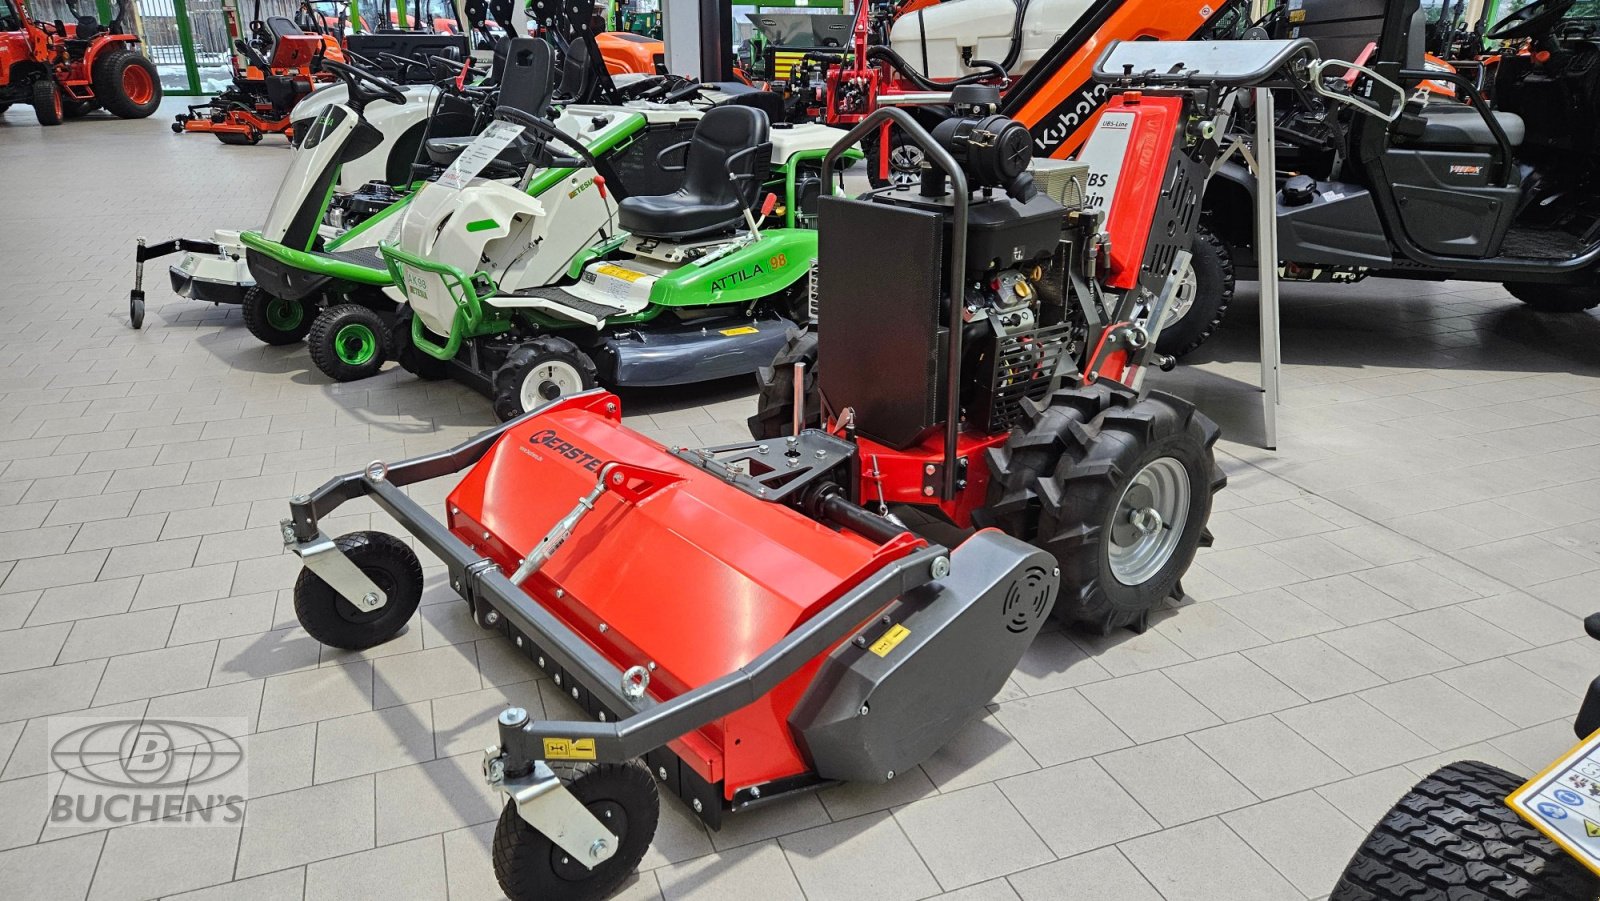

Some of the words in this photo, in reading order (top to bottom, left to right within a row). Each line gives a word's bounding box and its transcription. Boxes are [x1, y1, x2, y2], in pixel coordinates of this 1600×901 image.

[1102, 120, 1128, 128] UBS-Line
[1087, 173, 1109, 187] BS
[711, 264, 764, 294] ATTILA
[770, 253, 787, 270] 98
[529, 430, 602, 473] KERSTE
